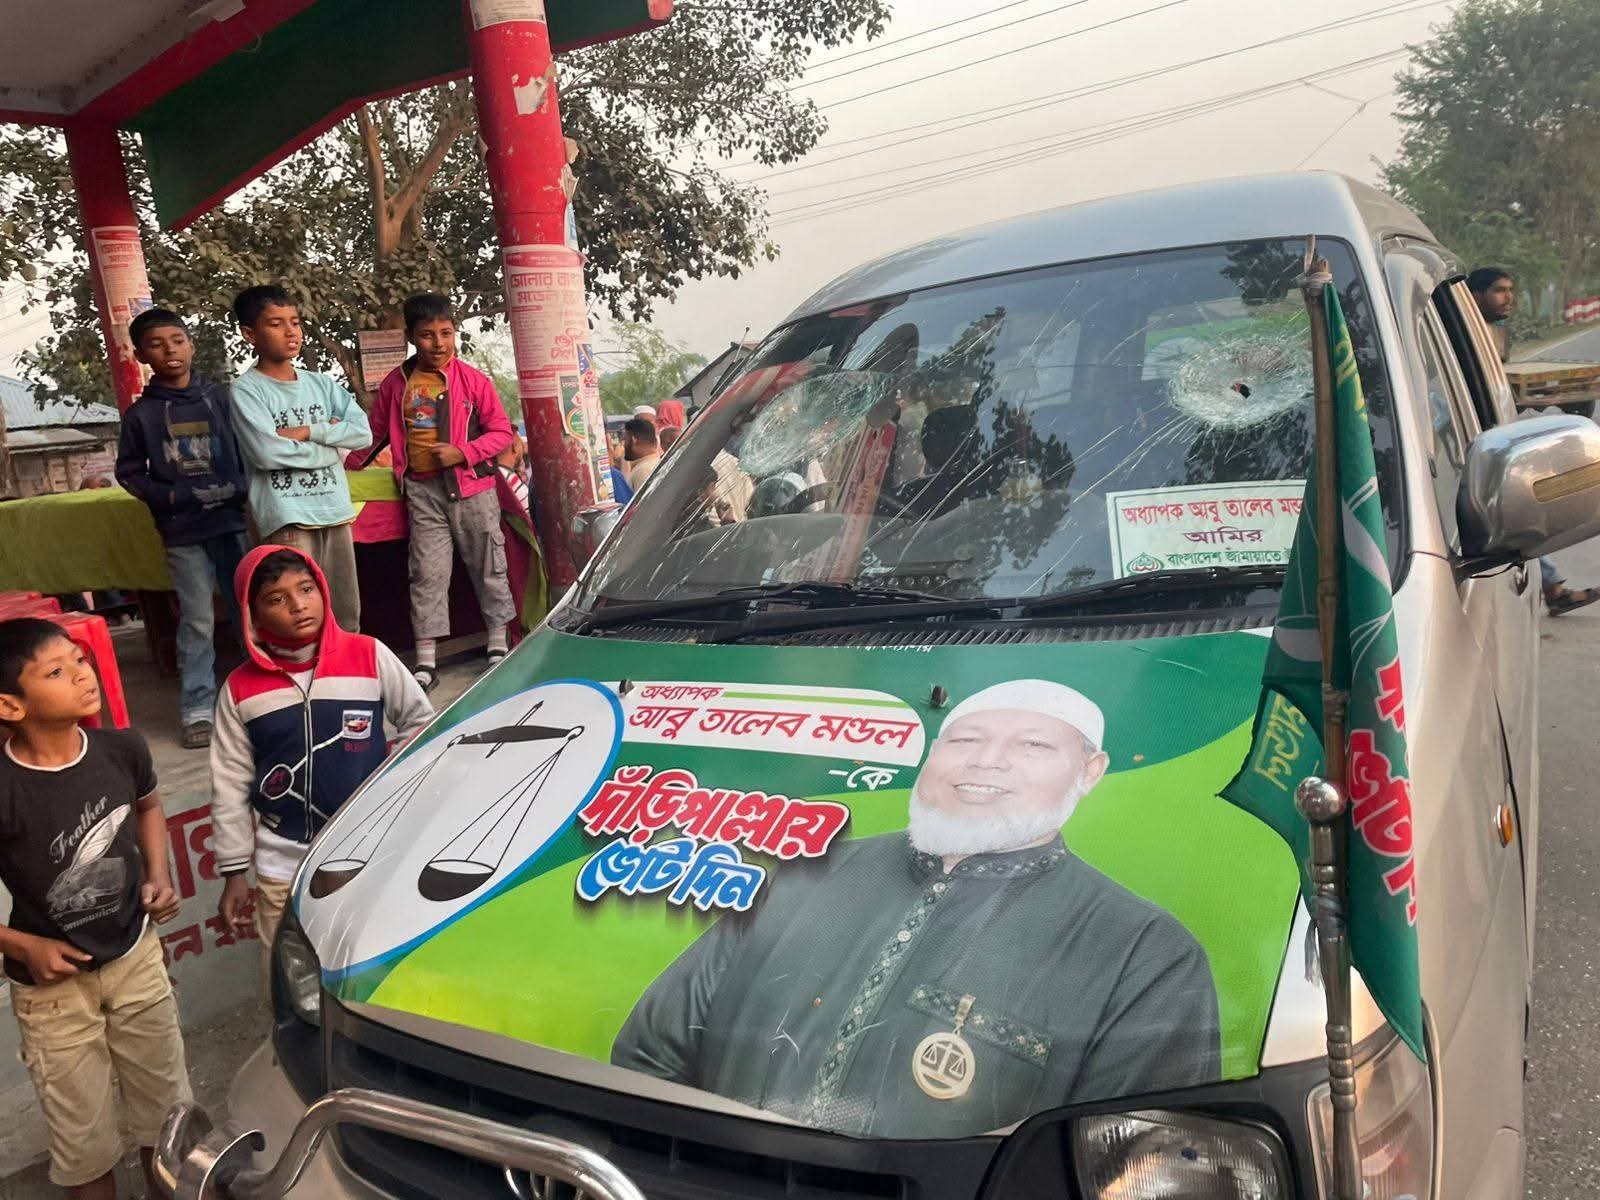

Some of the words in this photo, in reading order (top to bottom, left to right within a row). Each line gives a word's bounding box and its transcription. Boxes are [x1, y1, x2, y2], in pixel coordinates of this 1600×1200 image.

[1122, 502, 1184, 526] অধ্যাপক
[1188, 499, 1223, 524] আবু
[1223, 497, 1275, 518] তালেব
[1183, 525, 1264, 545] আমির
[1166, 551, 1222, 567] বাংলাদেশ
[640, 686, 724, 702] অধ্যাপক
[629, 705, 700, 740] আবু
[699, 708, 811, 738] তালেব
[50, 796, 107, 863] Feather
[575, 838, 697, 902] ভোট
[667, 842, 767, 911] দিন
